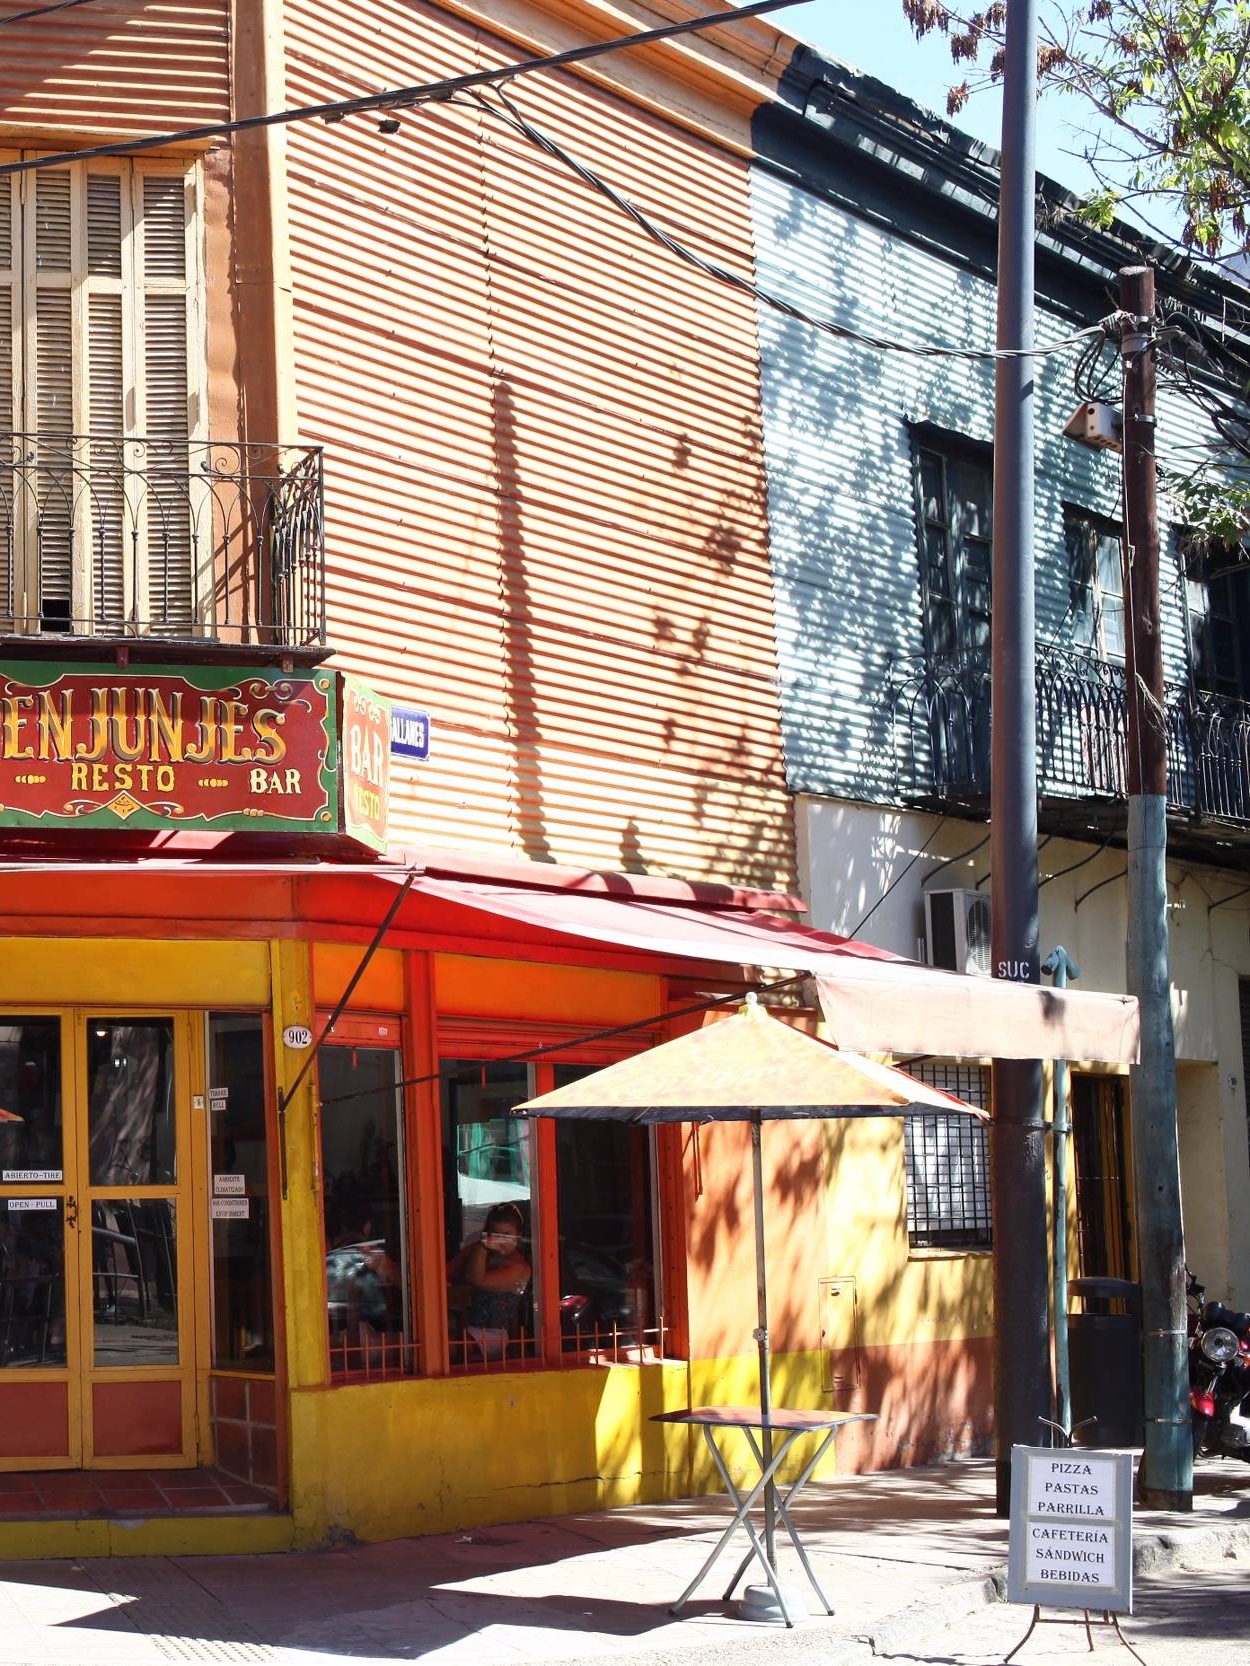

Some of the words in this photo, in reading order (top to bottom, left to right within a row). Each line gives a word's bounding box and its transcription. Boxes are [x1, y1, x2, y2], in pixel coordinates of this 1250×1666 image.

[350, 724, 384, 788] BAR
[71, 765, 174, 792] RESTO
[249, 770, 303, 796] BAR
[354, 783, 381, 822] RESTO
[289, 1031, 307, 1044] 902
[1051, 1463, 1092, 1475] PIZZA
[1045, 1482, 1099, 1495] PASTAS
[1038, 1502, 1104, 1516] PARRILLA
[1032, 1528, 1109, 1543] CAFETERÍA
[1040, 1569, 1100, 1583] BEBIDAS
